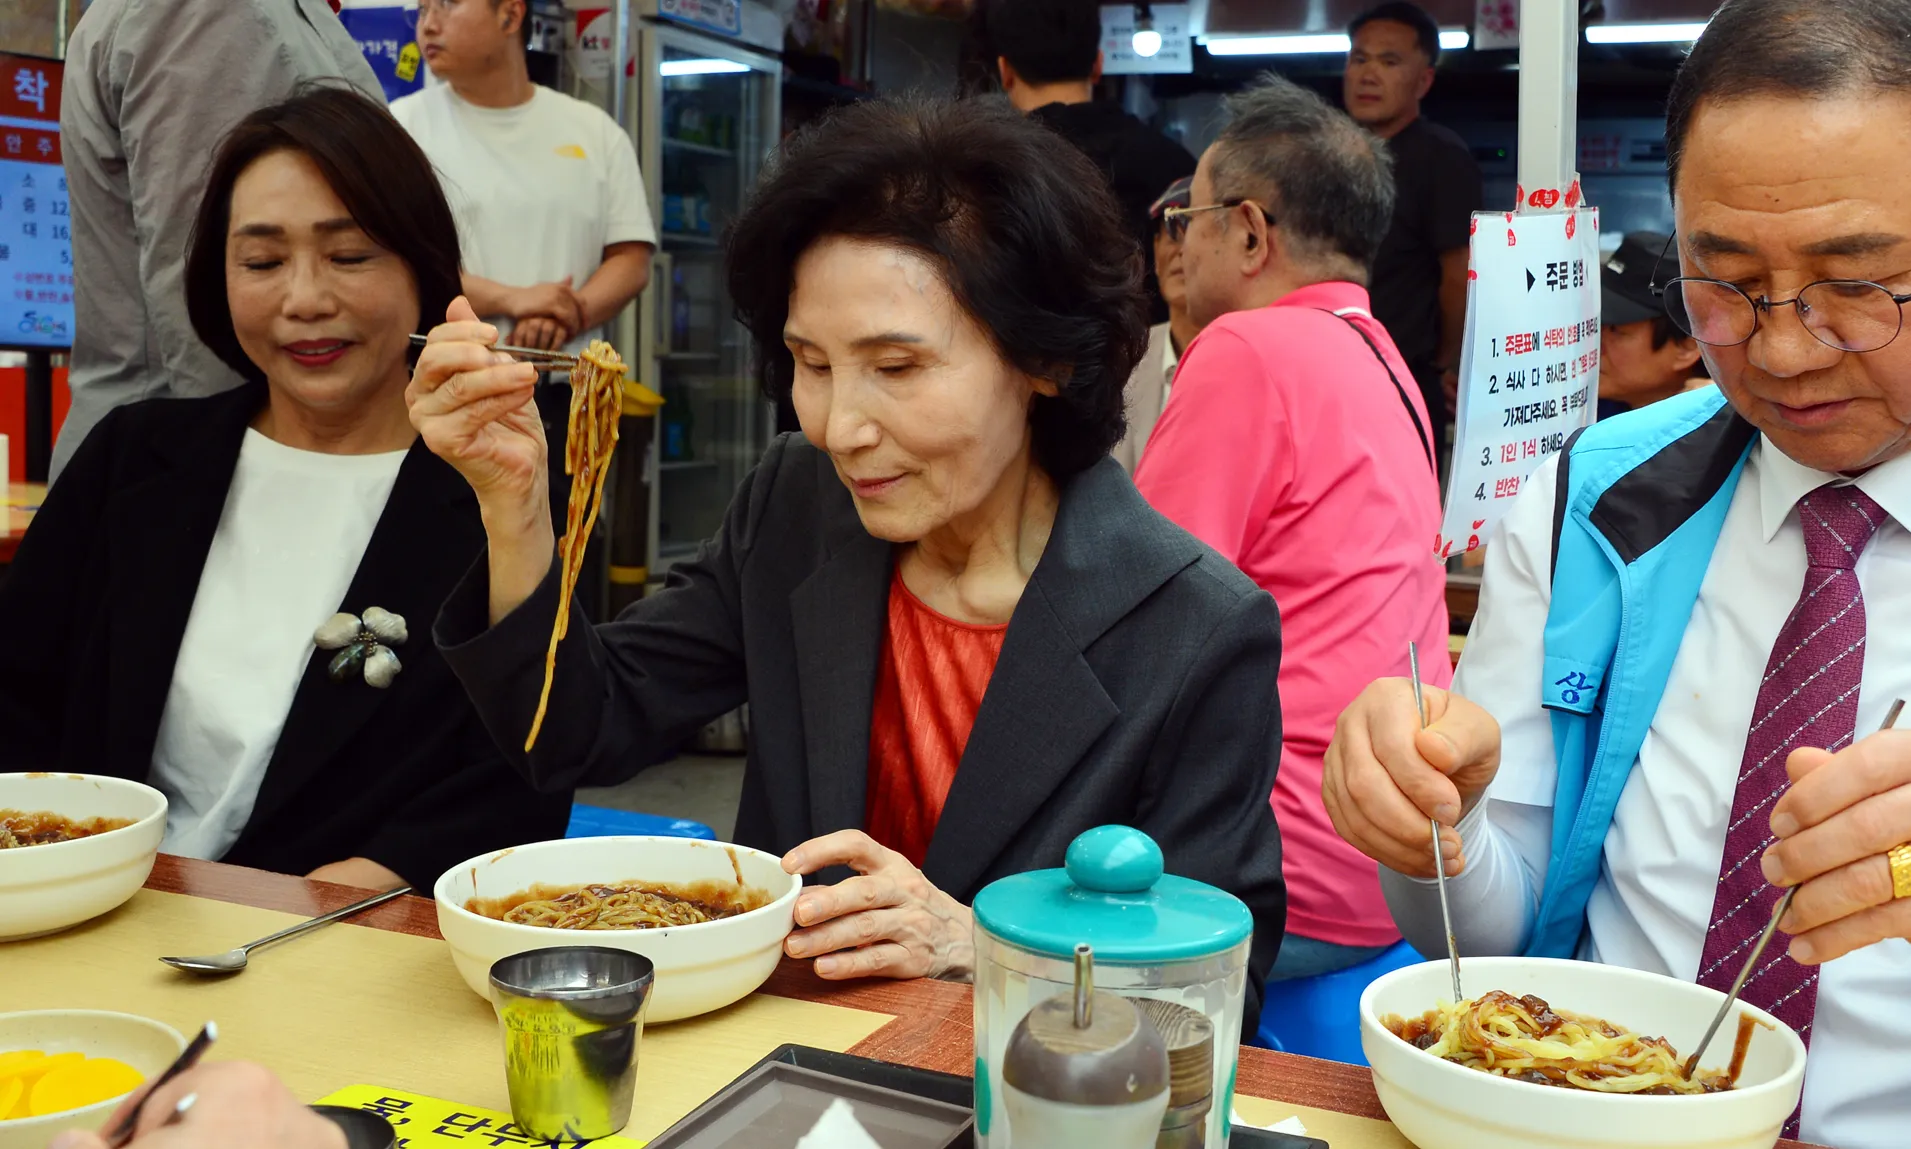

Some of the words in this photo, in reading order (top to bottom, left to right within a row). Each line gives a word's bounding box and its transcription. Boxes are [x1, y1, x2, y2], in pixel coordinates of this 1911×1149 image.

[582, 36, 598, 50] kt
[14, 68, 49, 112] 착
[22, 173, 35, 188] 소
[23, 222, 37, 239] 대
[1546, 261, 1568, 292] 주문
[1491, 338, 1500, 358] 1.
[1505, 331, 1540, 356] 주문표에
[1544, 327, 1565, 349] 식탁의
[1489, 375, 1499, 394] 2.
[1506, 370, 1525, 391] 식사
[1532, 367, 1540, 386] 다
[1481, 446, 1492, 466] 3.
[1500, 442, 1517, 463] 1인
[1522, 439, 1537, 458] 1식
[1474, 483, 1487, 501] 4.
[1494, 476, 1520, 499] 반찬
[1555, 671, 1594, 704] 상
